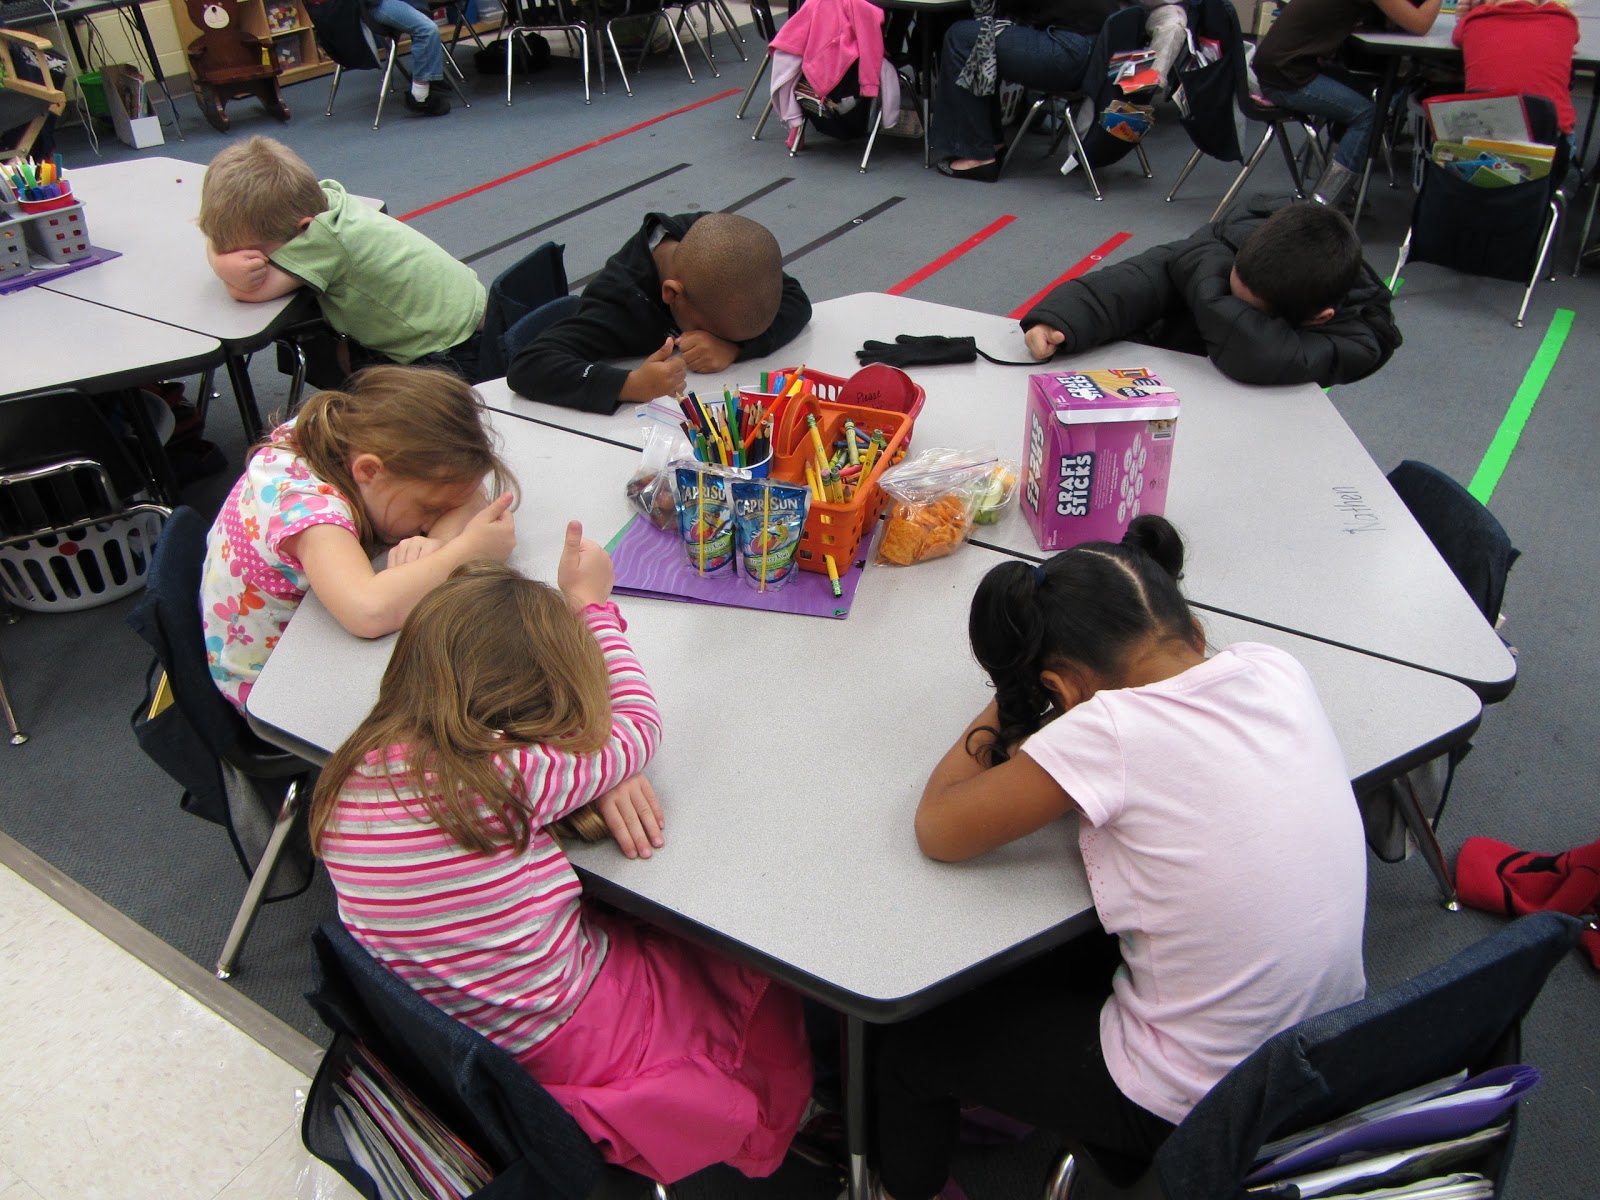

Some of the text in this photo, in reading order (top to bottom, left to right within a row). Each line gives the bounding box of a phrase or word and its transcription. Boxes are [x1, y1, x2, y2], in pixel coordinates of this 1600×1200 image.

[856, 390, 882, 404] Please
[1057, 457, 1077, 516] CRAFT
[1071, 454, 1092, 516] STICKS
[1331, 486, 1387, 535] Nathen
